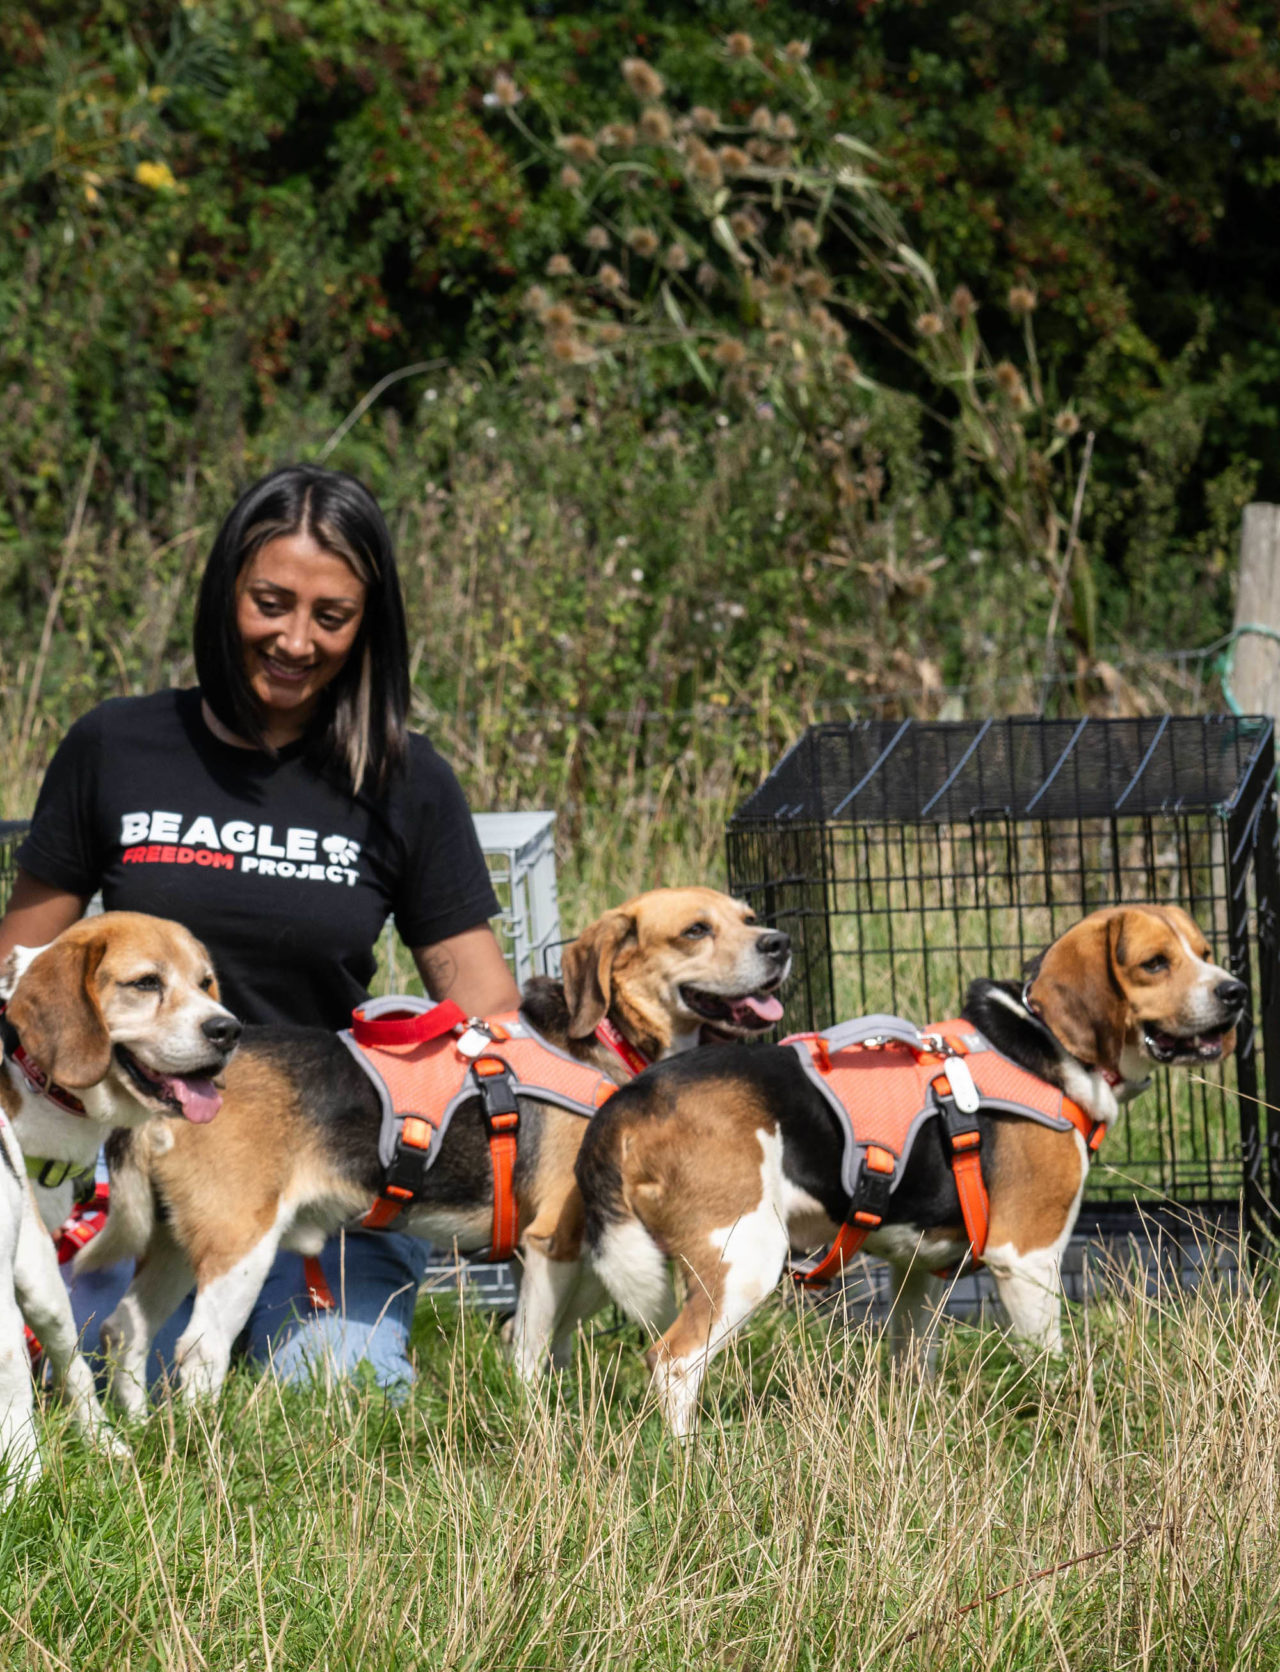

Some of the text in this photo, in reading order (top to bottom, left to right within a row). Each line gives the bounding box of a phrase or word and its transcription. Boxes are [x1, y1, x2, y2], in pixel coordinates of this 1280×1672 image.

[120, 811, 318, 862] BEAGLE
[122, 845, 360, 887] FREEDOM PROJECT
